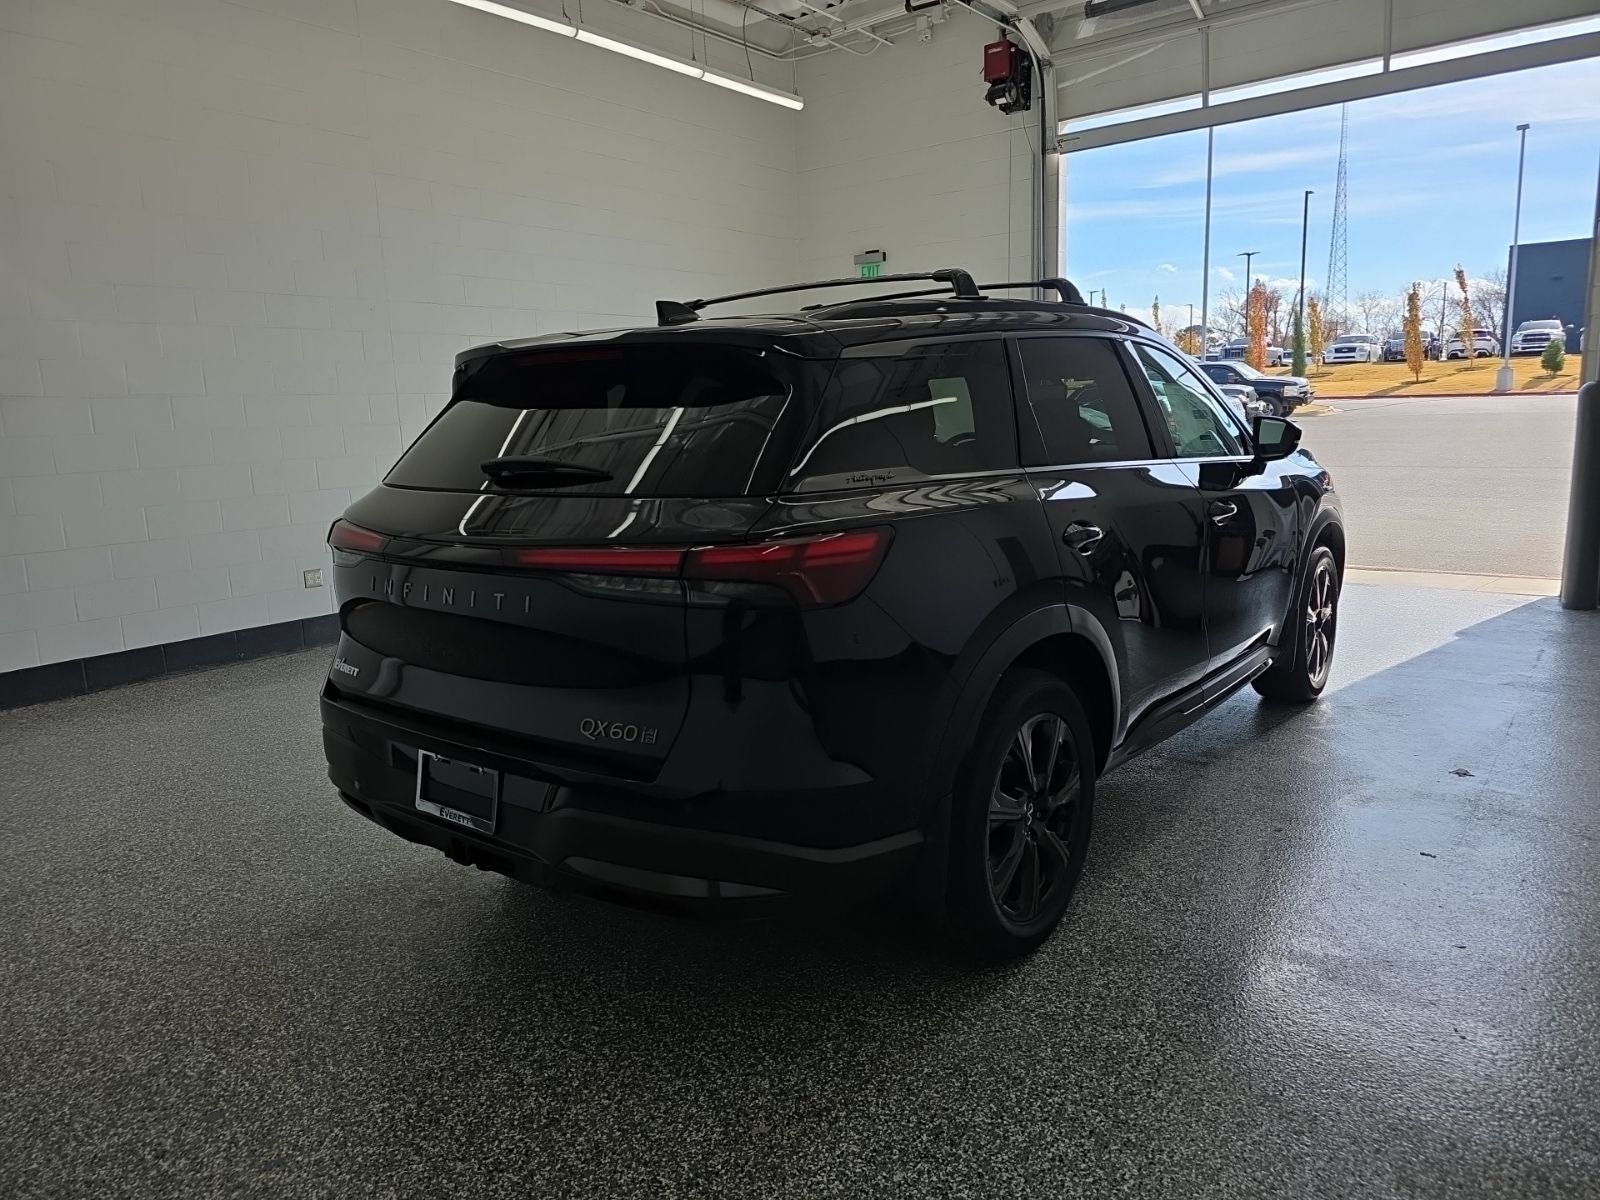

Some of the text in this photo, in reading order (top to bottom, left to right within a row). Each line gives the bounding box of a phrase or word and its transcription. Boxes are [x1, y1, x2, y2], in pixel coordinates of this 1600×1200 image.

[861, 264, 880, 278] EXIT
[371, 575, 532, 613] INFINITI
[579, 717, 639, 742] QX60
[440, 807, 473, 825] EVERETT
